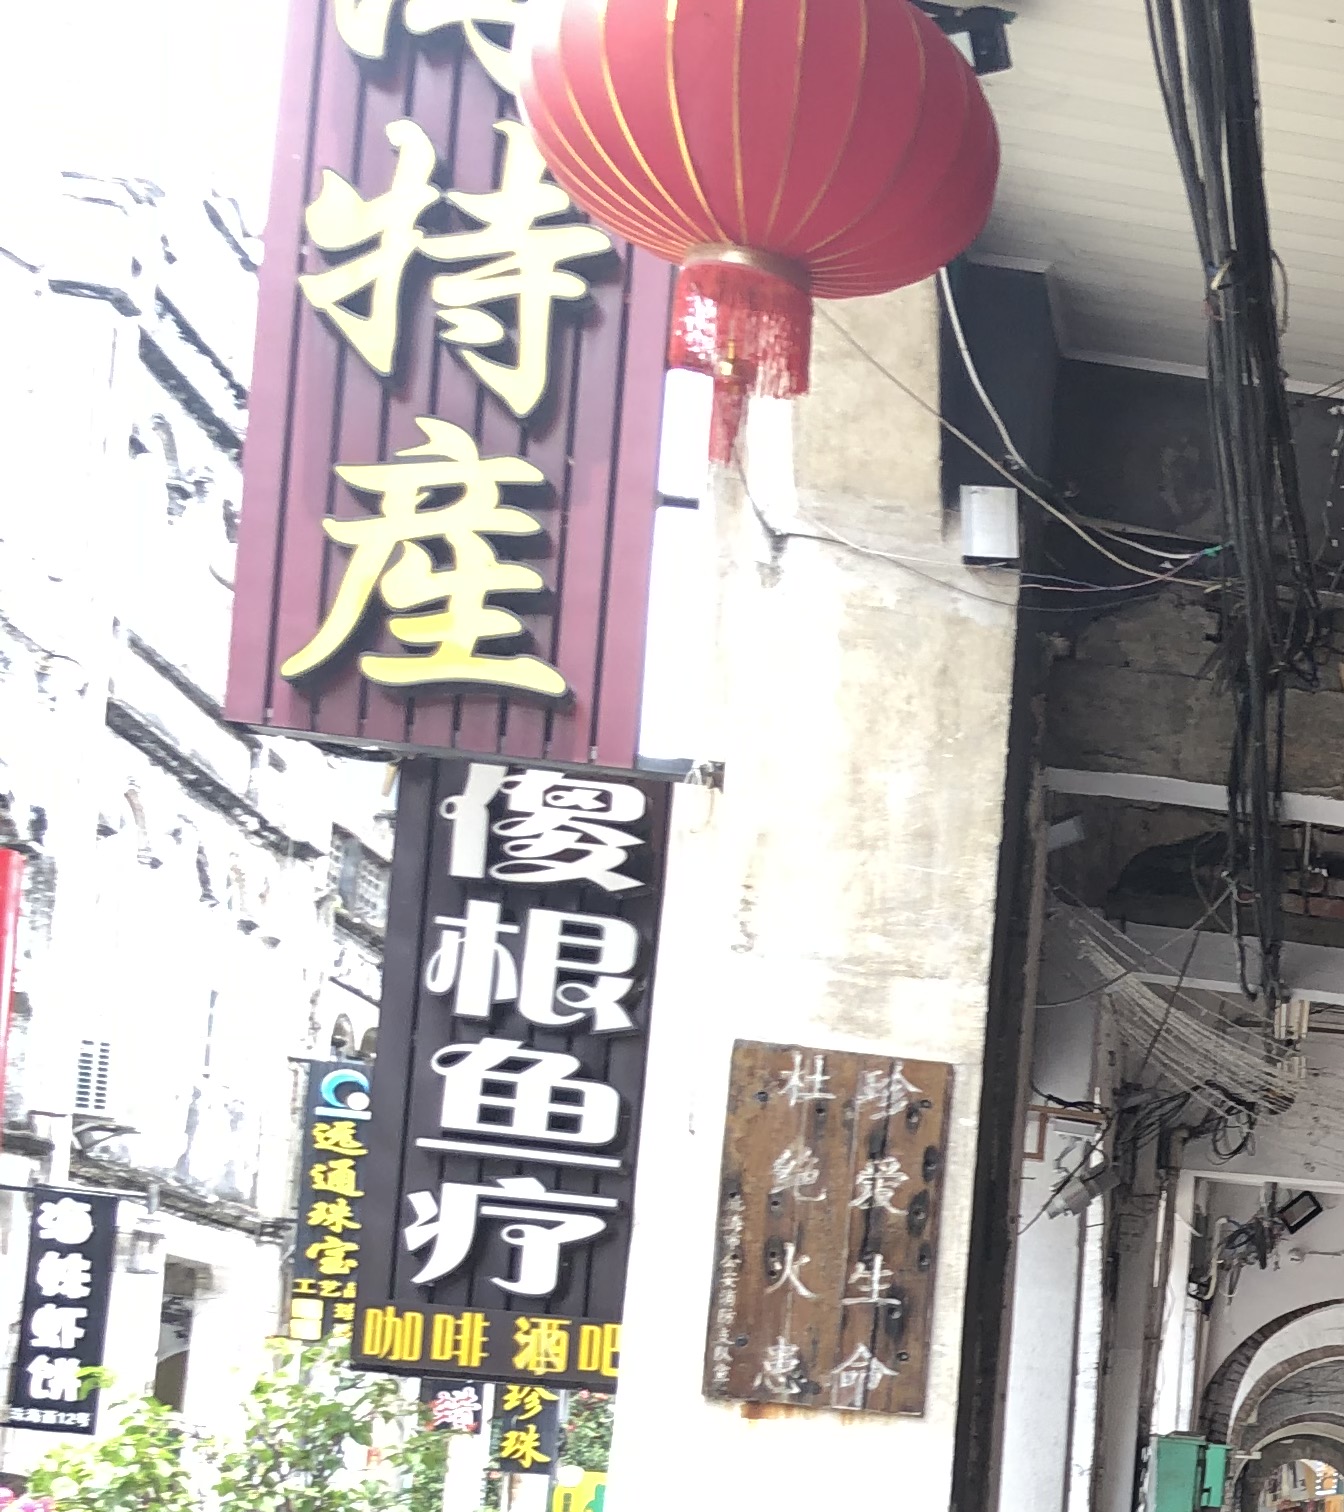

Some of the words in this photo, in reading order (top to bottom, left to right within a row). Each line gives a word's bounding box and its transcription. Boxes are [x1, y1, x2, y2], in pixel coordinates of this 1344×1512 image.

[404, 763, 648, 1297] 傻根鱼疗
[362, 1305, 490, 1368] 咖啡
[512, 1316, 621, 1378] 酒吧
[500, 1384, 561, 1469] 珍珠
